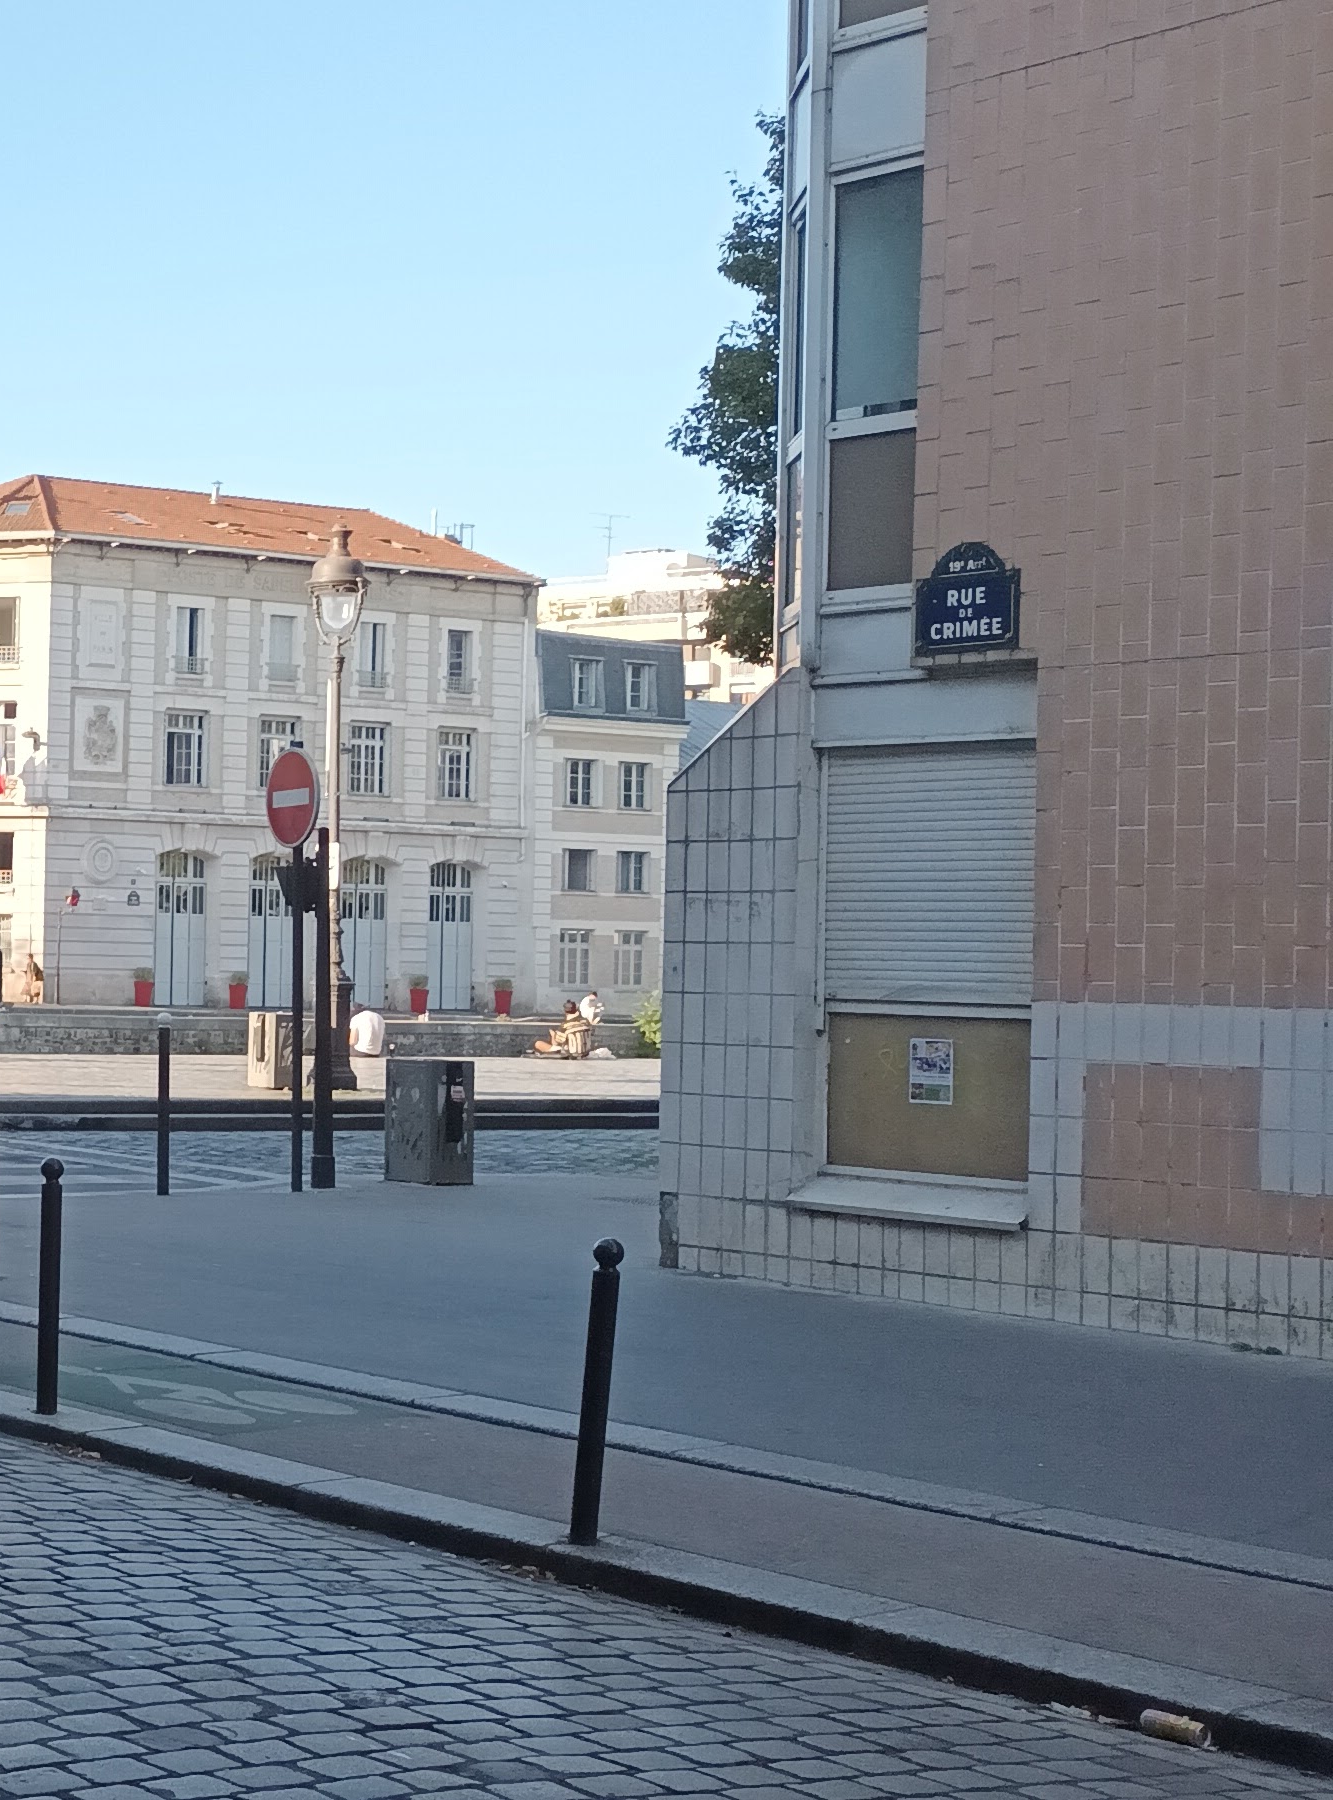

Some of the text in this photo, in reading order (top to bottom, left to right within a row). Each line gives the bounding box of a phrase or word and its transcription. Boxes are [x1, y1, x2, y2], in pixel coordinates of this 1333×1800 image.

[946, 586, 986, 607] RUE
[958, 608, 973, 617] DE
[930, 616, 1003, 639] CRIMÉE
